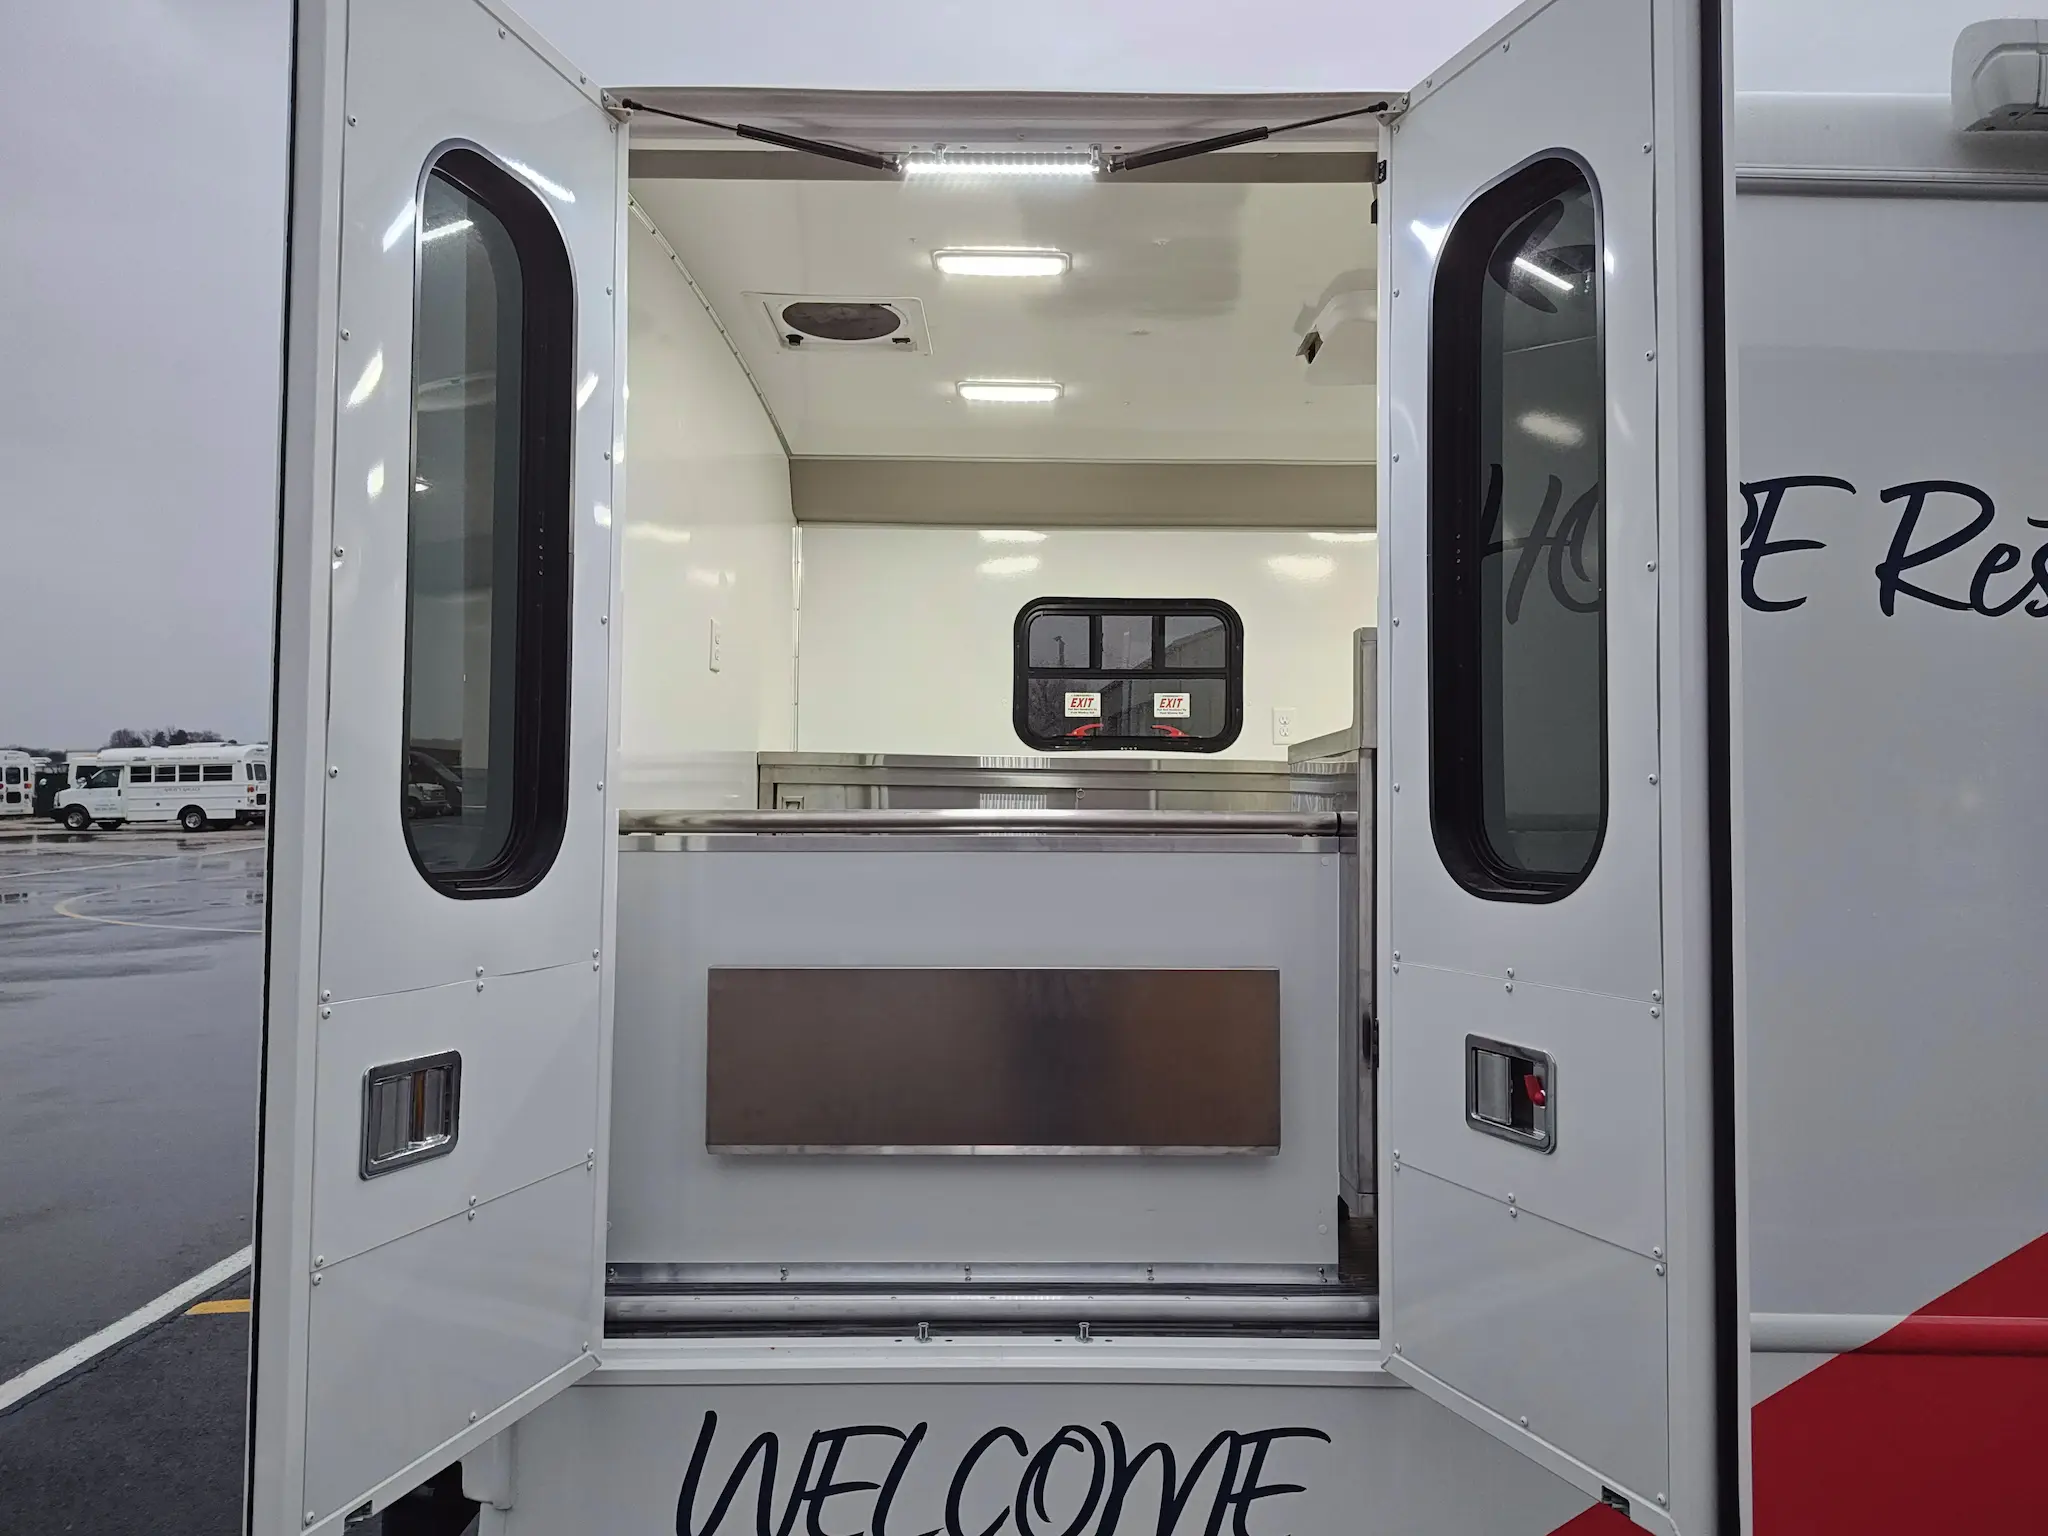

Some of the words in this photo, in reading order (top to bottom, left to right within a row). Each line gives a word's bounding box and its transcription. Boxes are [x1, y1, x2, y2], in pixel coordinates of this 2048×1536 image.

[1070, 697, 1095, 708] EXIT
[1159, 697, 1184, 708] EXIT
[676, 1410, 1331, 1536] WELCOME
